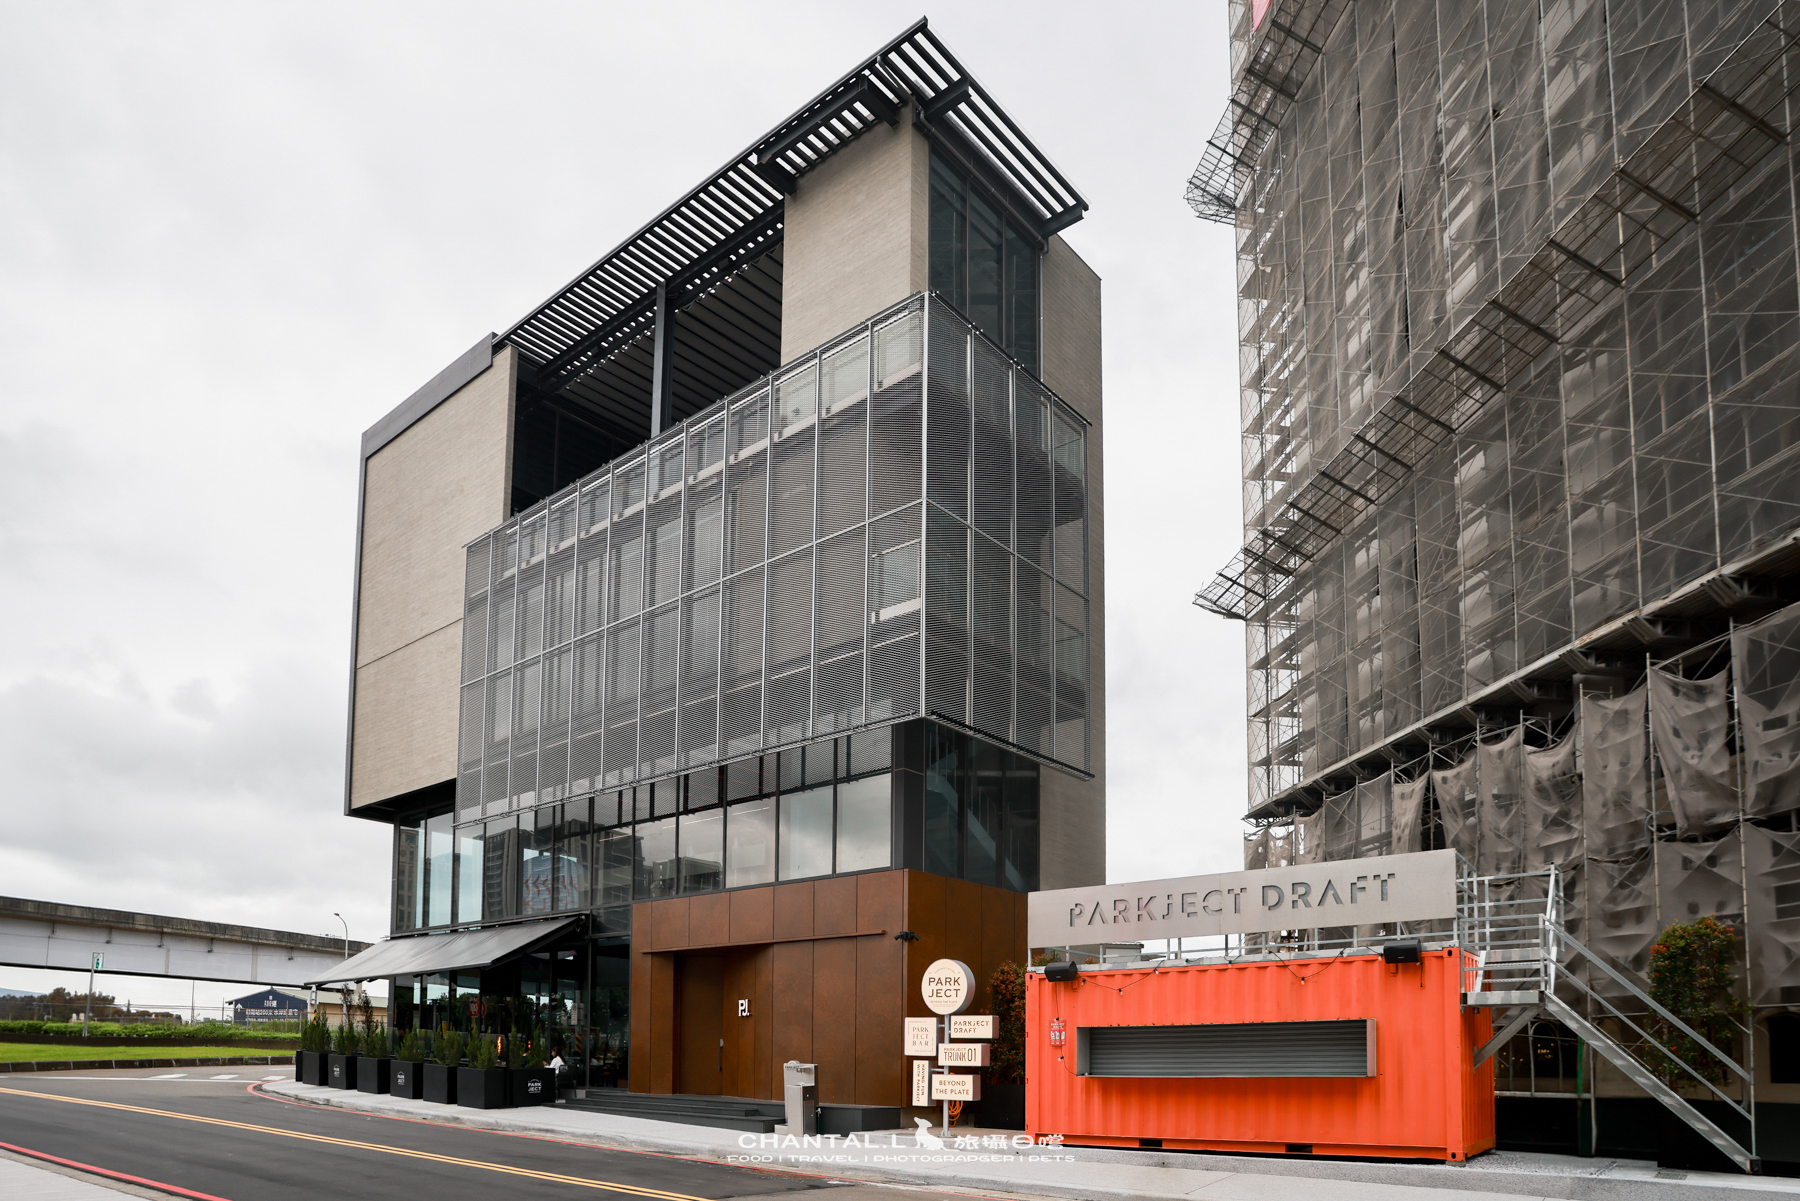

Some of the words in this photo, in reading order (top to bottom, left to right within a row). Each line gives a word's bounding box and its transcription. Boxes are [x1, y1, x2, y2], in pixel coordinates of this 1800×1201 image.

[1069, 887, 1247, 927] PARKJECT
[1262, 873, 1396, 911] DRAFT
[928, 976, 961, 987] PARK
[928, 988, 961, 998] JECT
[943, 1051, 967, 1062] TRUNK
[967, 1047, 977, 1062] 01
[950, 1088, 970, 1096] PLATE
